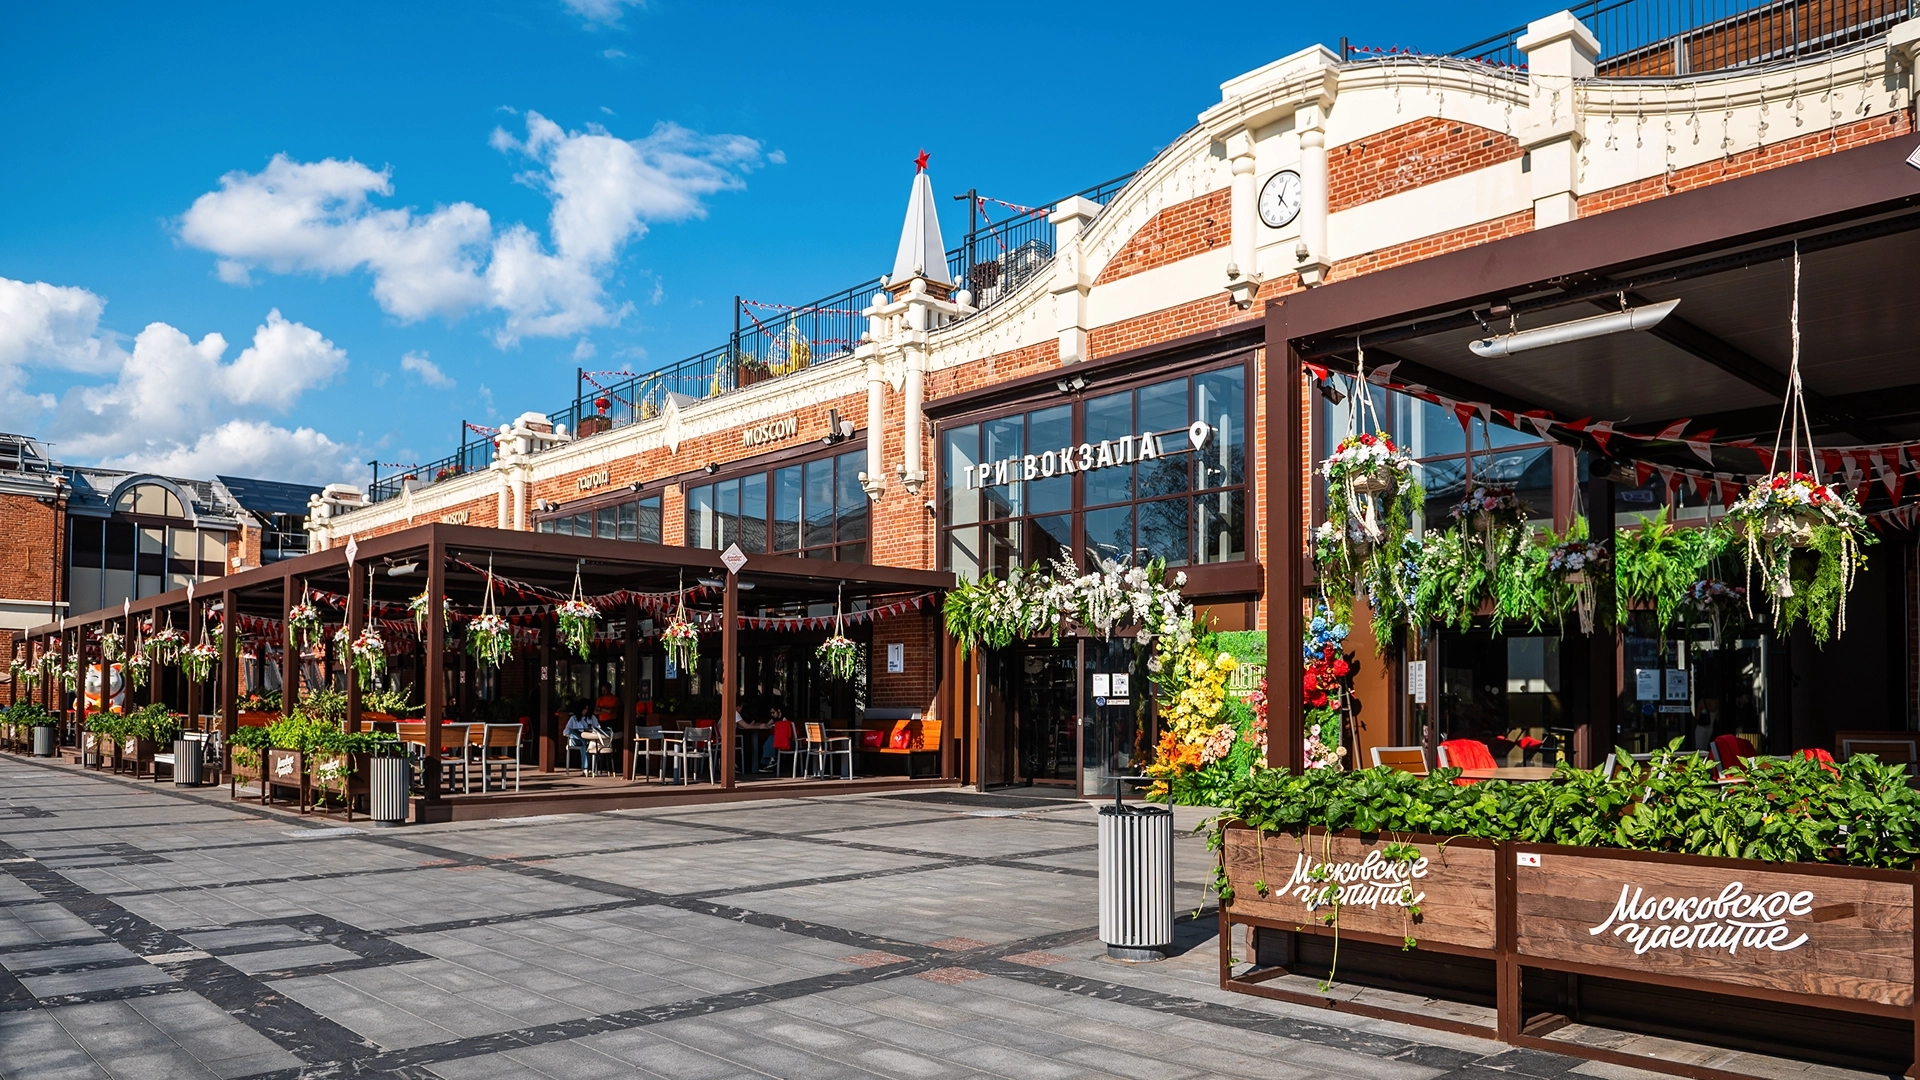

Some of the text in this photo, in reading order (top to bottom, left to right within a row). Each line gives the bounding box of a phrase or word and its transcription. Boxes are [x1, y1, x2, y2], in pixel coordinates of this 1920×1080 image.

[744, 416, 798, 447] MOSCOW
[963, 431, 1158, 490] ТРИ ВОКЗАЛА
[1588, 881, 1814, 936] Московское
[1613, 918, 1809, 955] чаепитие
